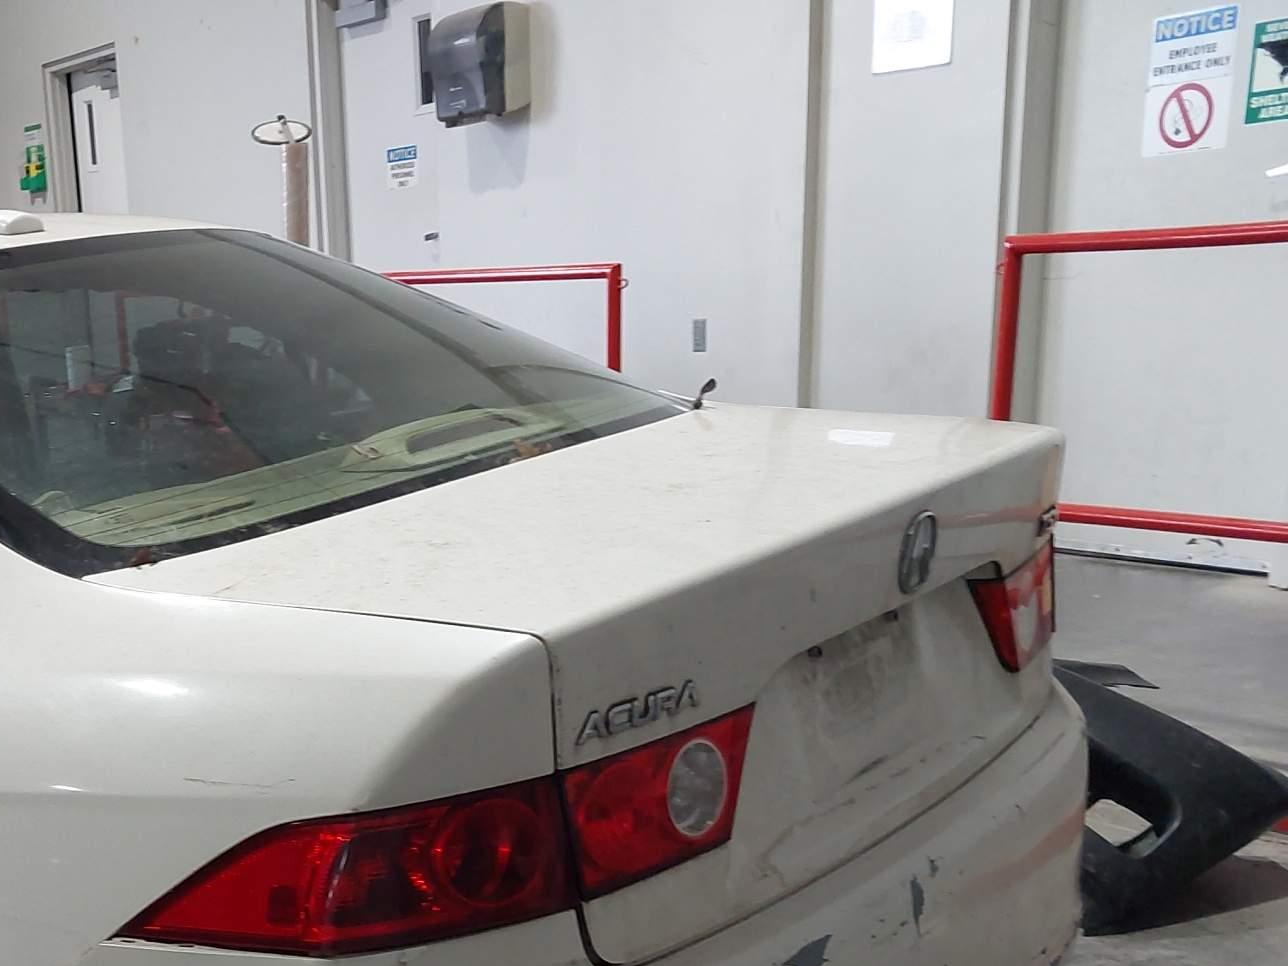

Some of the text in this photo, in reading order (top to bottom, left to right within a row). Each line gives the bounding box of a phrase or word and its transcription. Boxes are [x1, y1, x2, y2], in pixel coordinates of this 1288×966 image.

[1156, 9, 1236, 39] NOTICE
[1168, 42, 1218, 60] EMPLOYEE
[1152, 55, 1232, 77] ENTRANCE ONLY
[574, 679, 698, 746] ACURA
